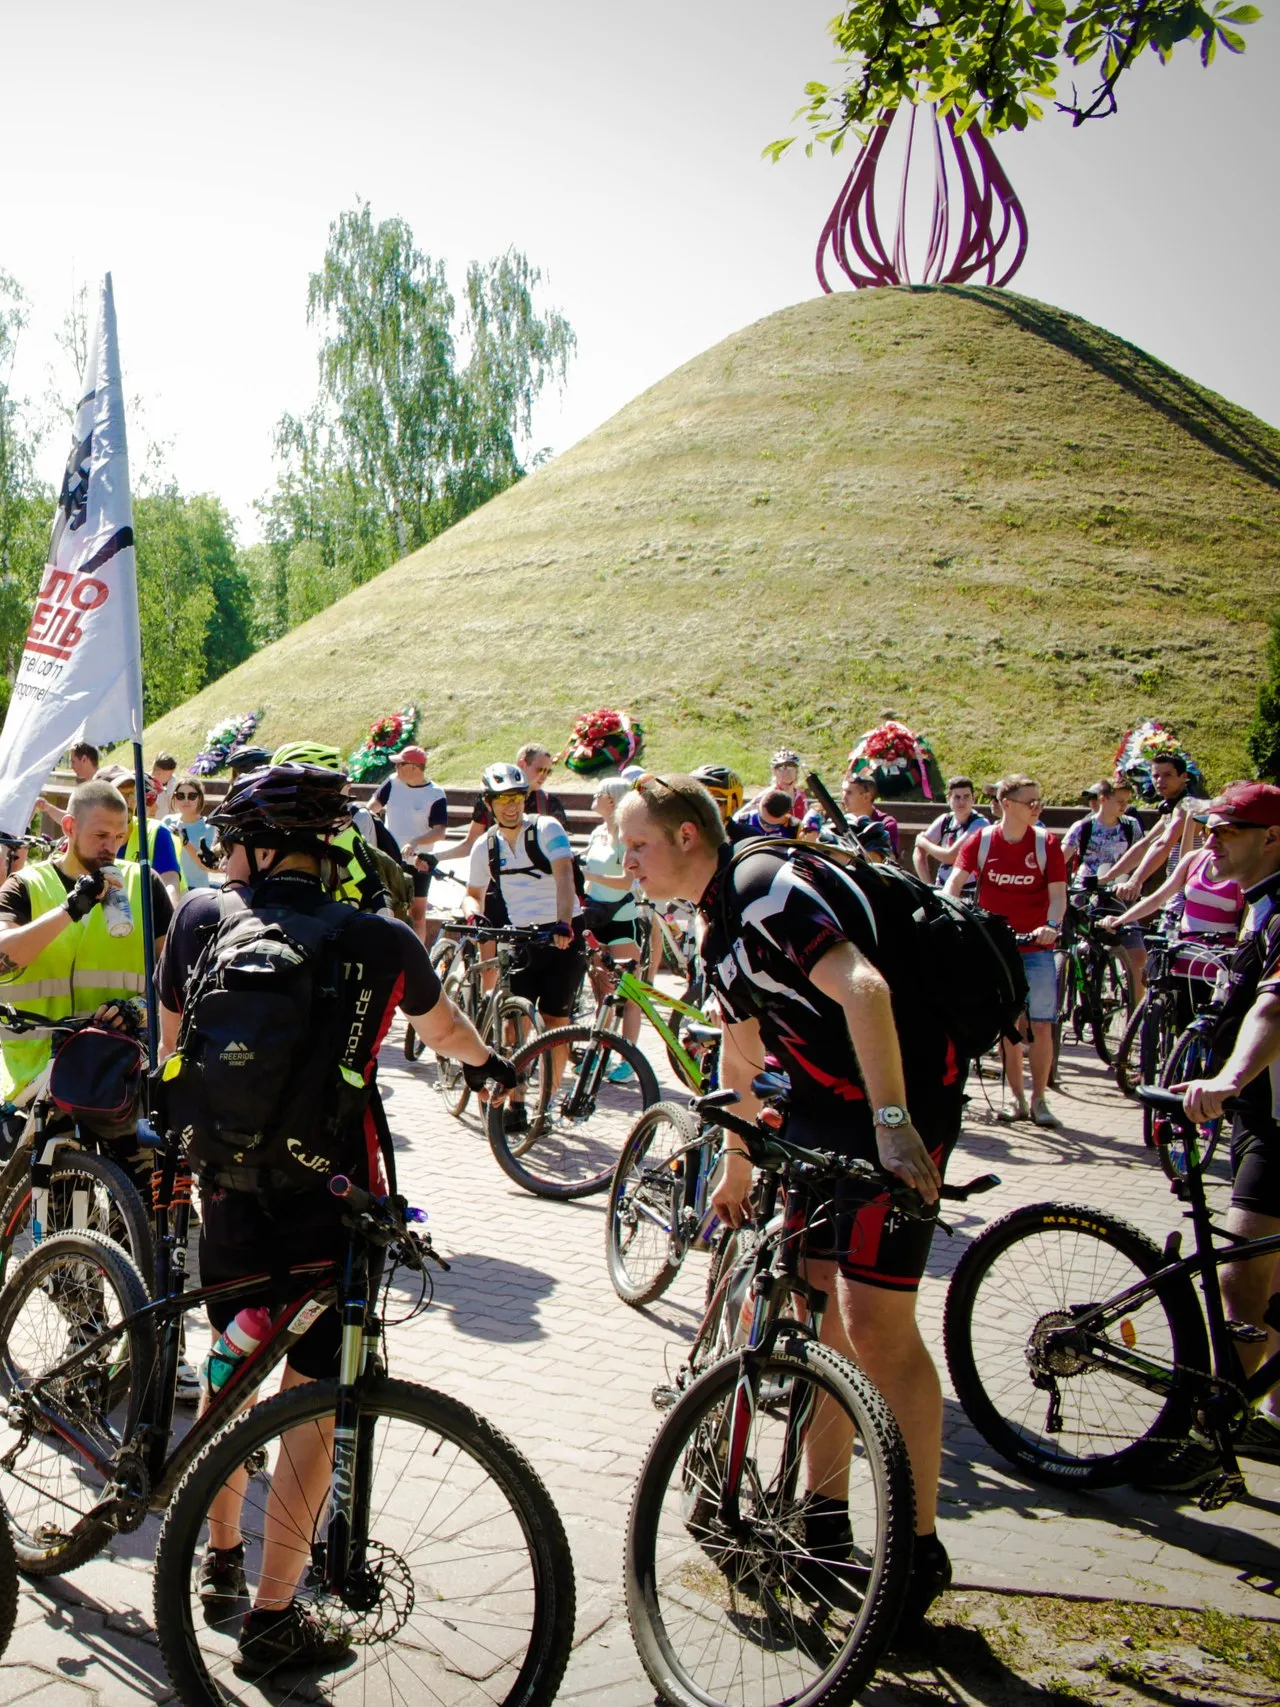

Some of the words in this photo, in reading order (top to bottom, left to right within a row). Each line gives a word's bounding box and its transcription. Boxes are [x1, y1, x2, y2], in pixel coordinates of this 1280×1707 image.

[36, 569, 110, 611] ЛО
[26, 602, 83, 648] ЕЛЬ
[987, 868, 1035, 886] tipico
[220, 1052, 254, 1061] FREERIDE
[1042, 1216, 1108, 1235] MAXXIS
[328, 1444, 354, 1527] FOX
